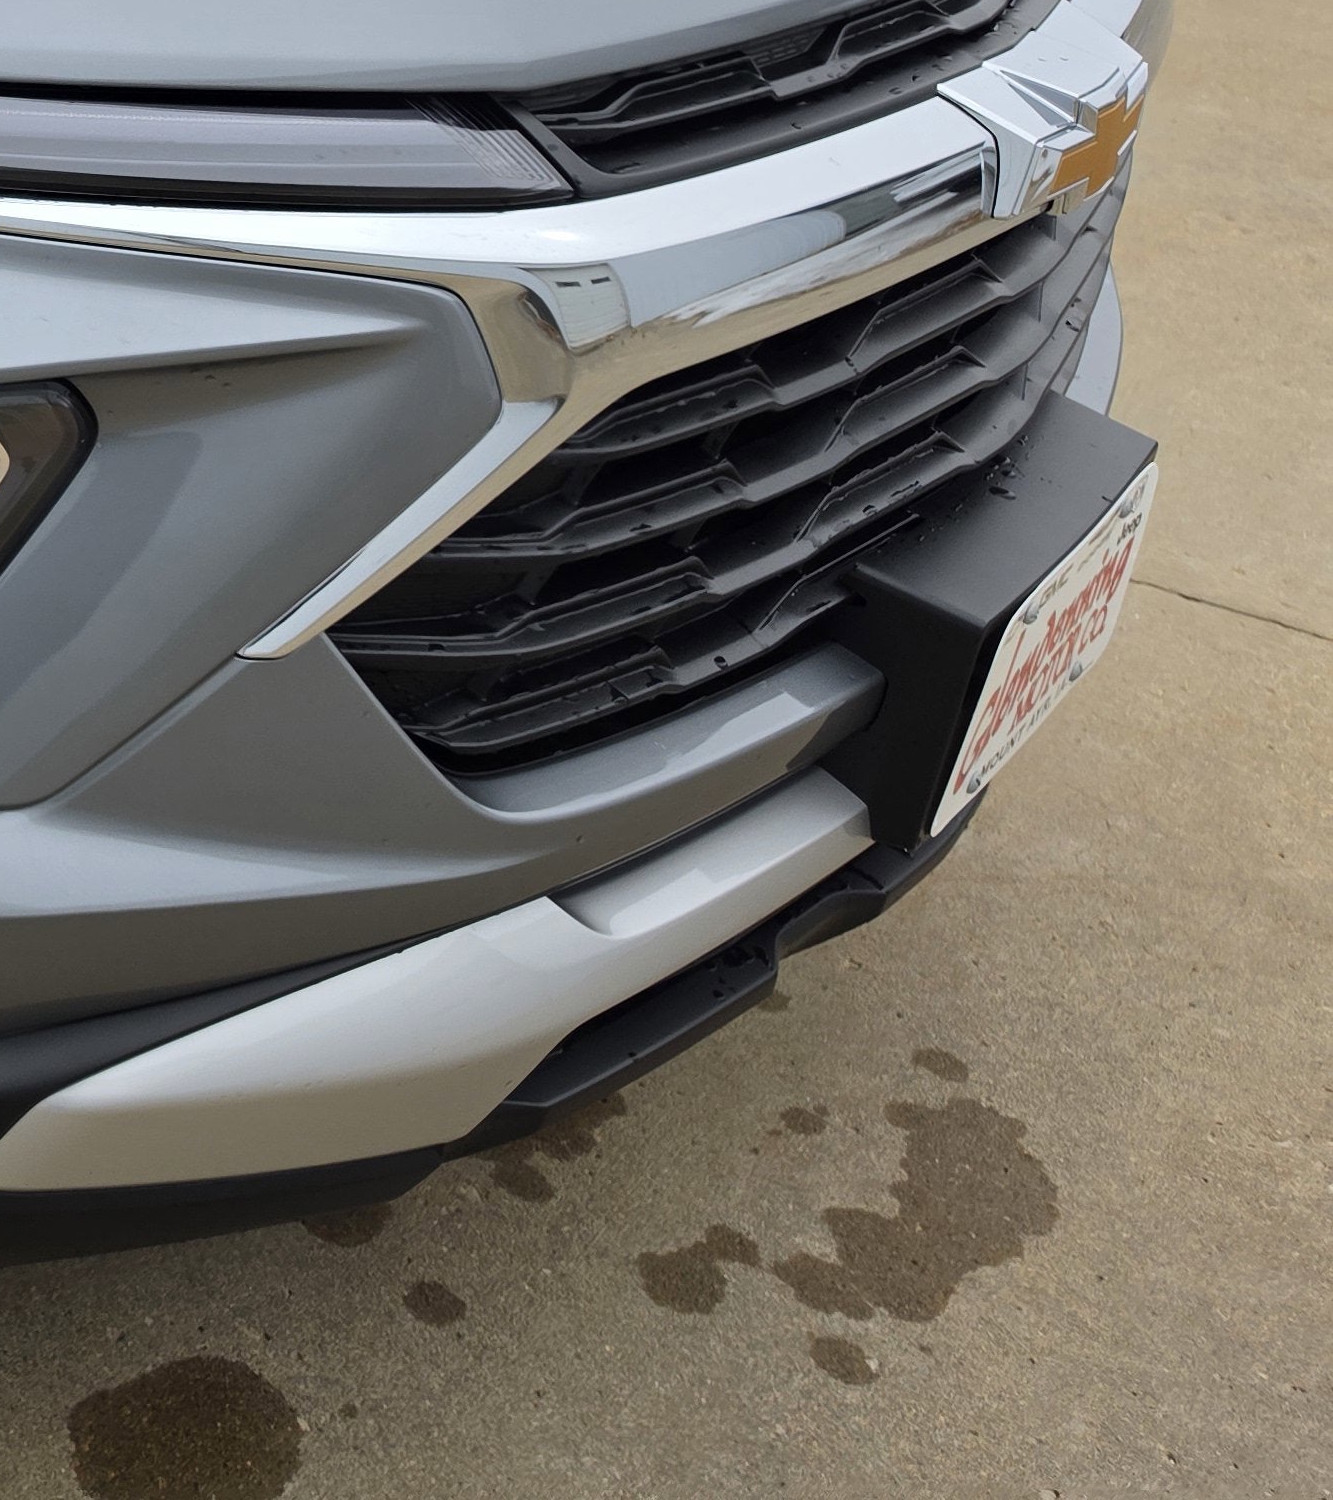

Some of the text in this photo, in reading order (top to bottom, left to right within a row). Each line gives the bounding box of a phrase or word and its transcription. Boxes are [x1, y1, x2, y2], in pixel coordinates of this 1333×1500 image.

[953, 536, 1135, 795] Glendenning
[1008, 622, 1082, 735] MOTOR
[980, 723, 1027, 777] MOUNT
